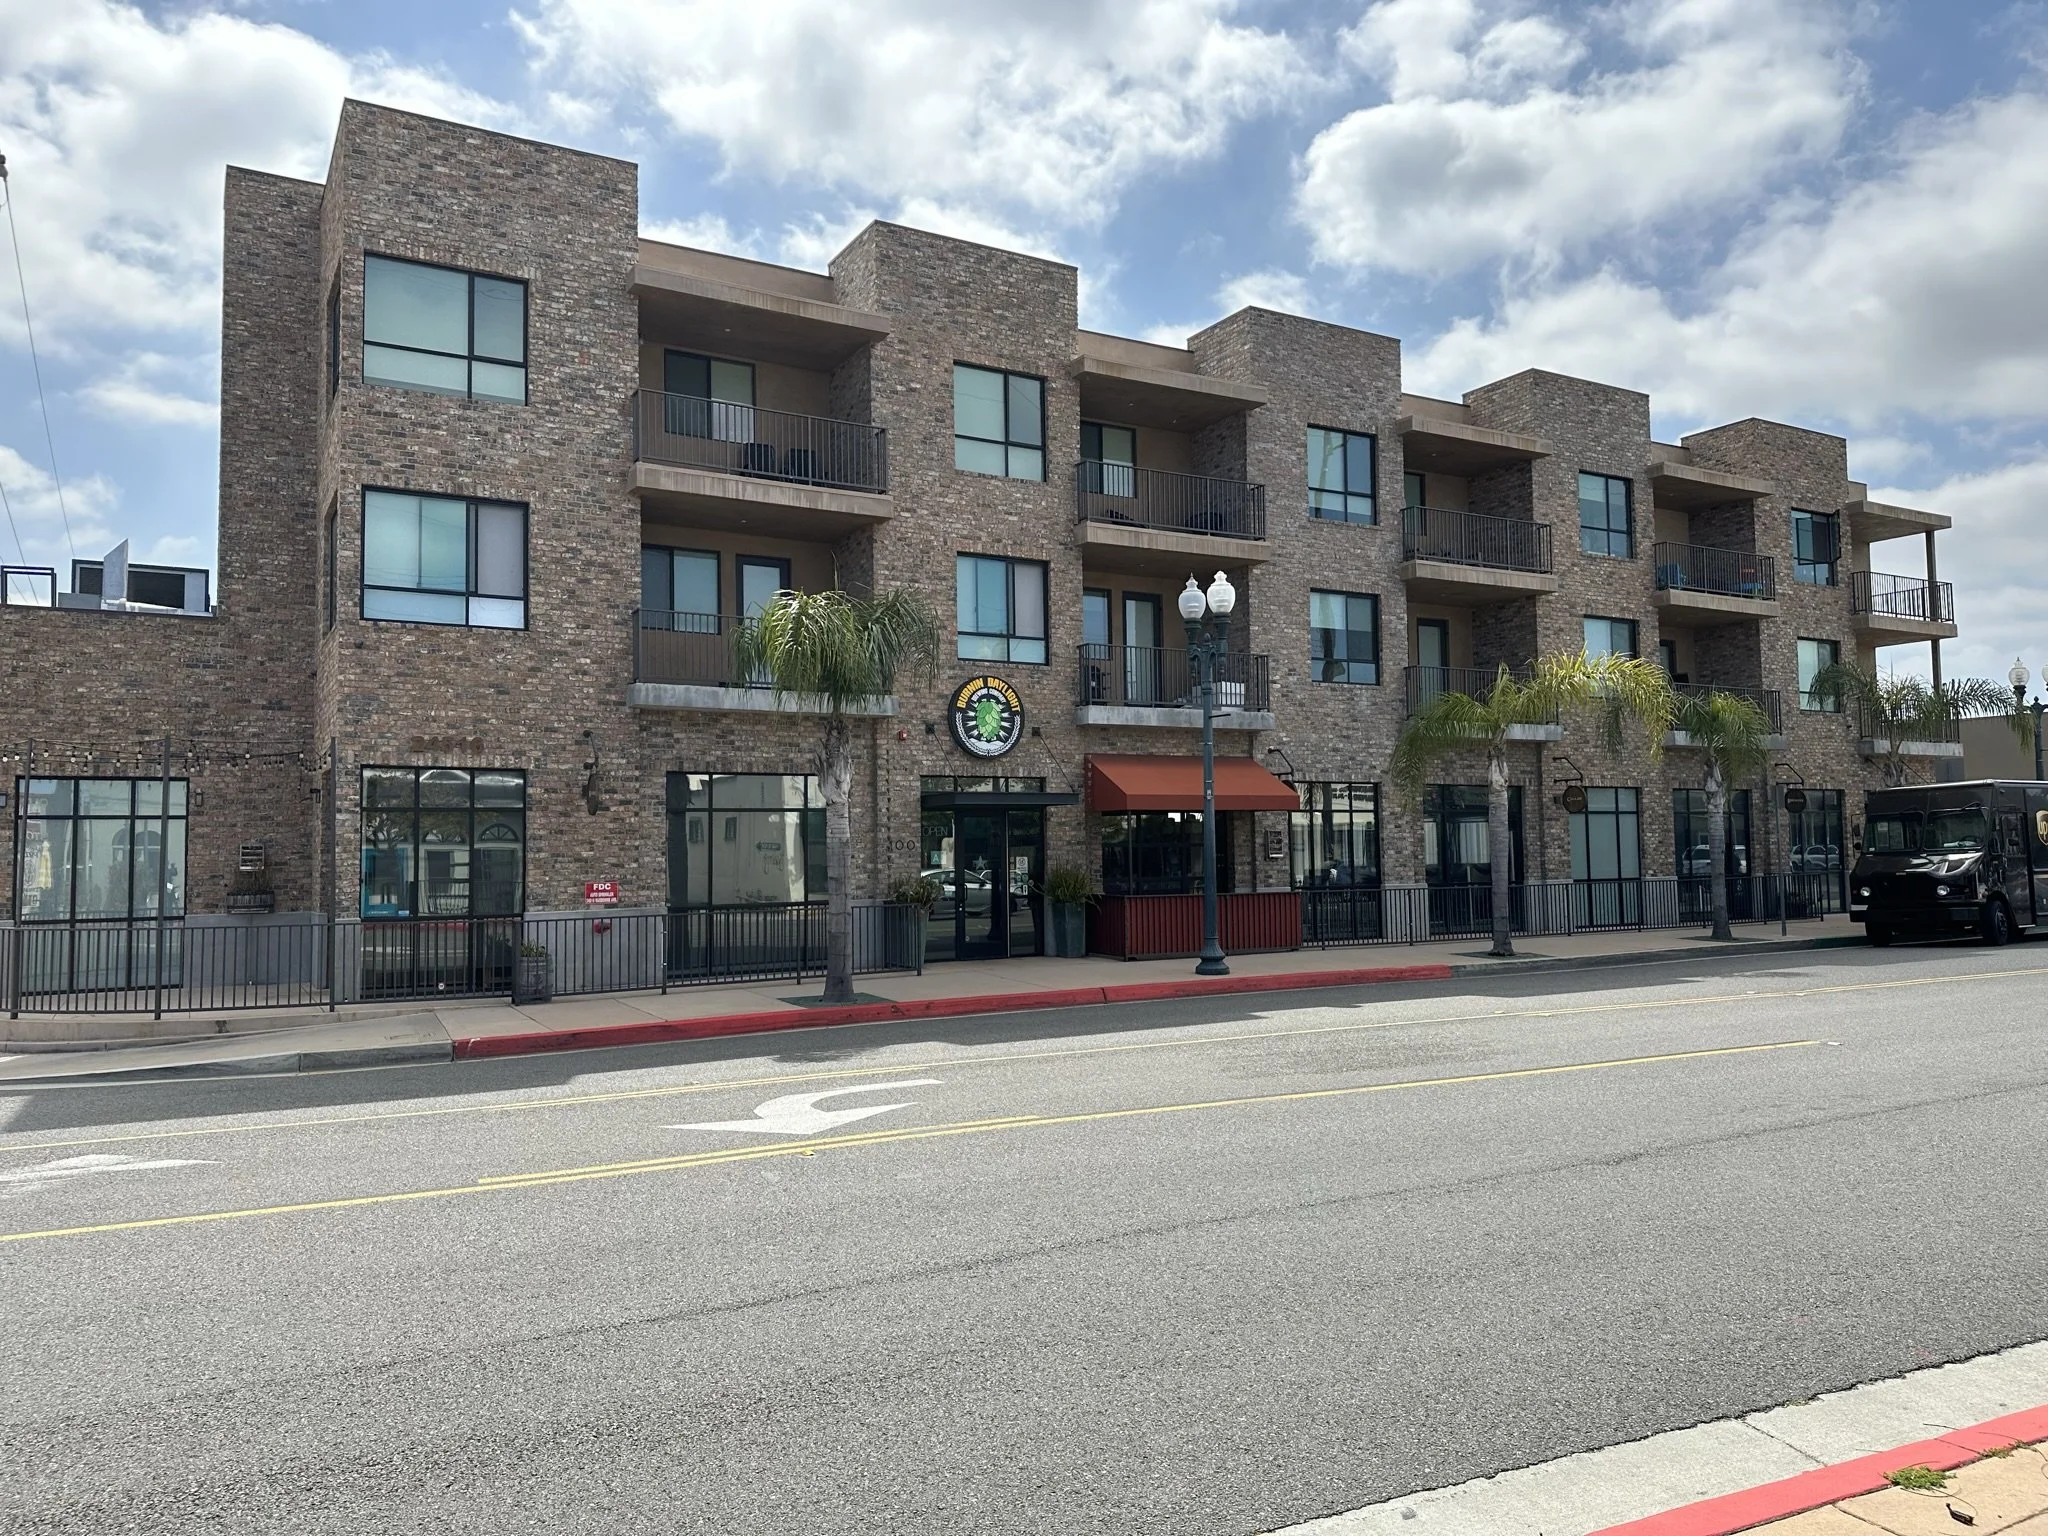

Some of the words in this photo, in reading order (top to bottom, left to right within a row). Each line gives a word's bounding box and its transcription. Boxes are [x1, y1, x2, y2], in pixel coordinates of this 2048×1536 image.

[956, 677, 984, 709] BURNIN
[987, 677, 1021, 712] DAYLIGHT
[923, 826, 948, 837] OPEN
[932, 853, 940, 863] A
